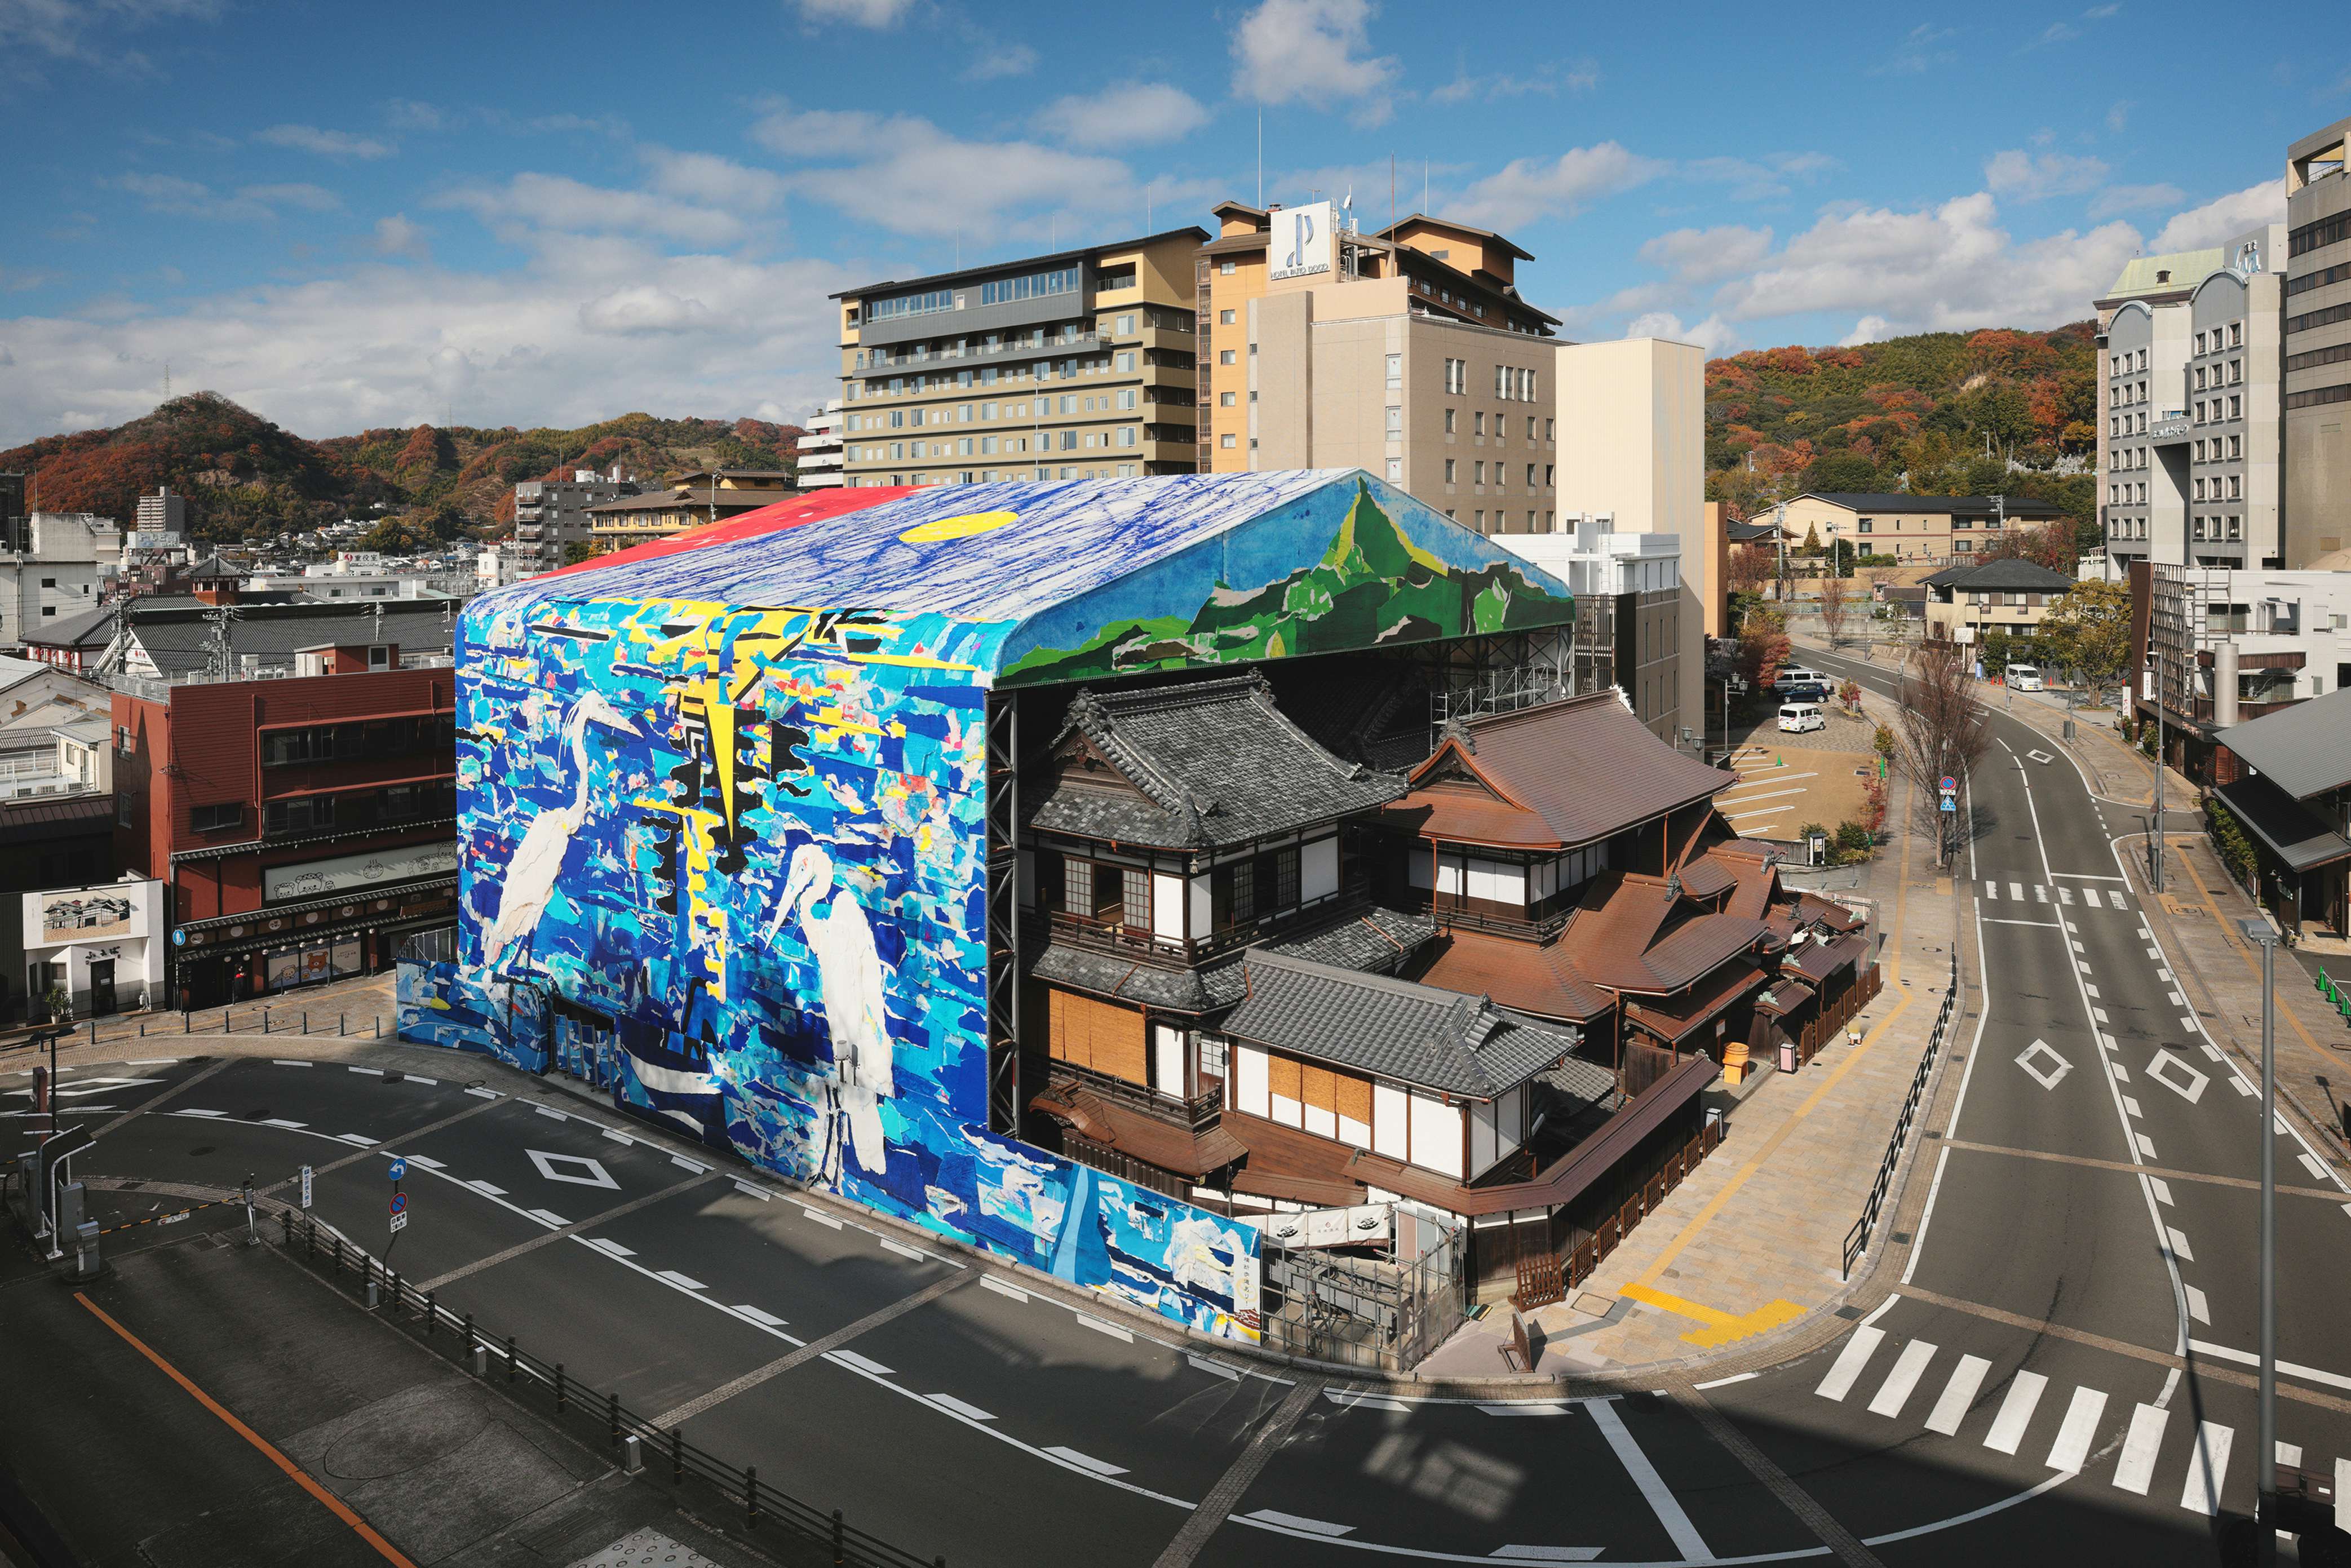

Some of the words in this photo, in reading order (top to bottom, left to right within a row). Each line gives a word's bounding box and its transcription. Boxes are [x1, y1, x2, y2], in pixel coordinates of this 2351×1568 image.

[1271, 270, 1288, 279] HOTEL
[1308, 263, 1329, 272] DOGO
[392, 1213, 405, 1224] 自動車
